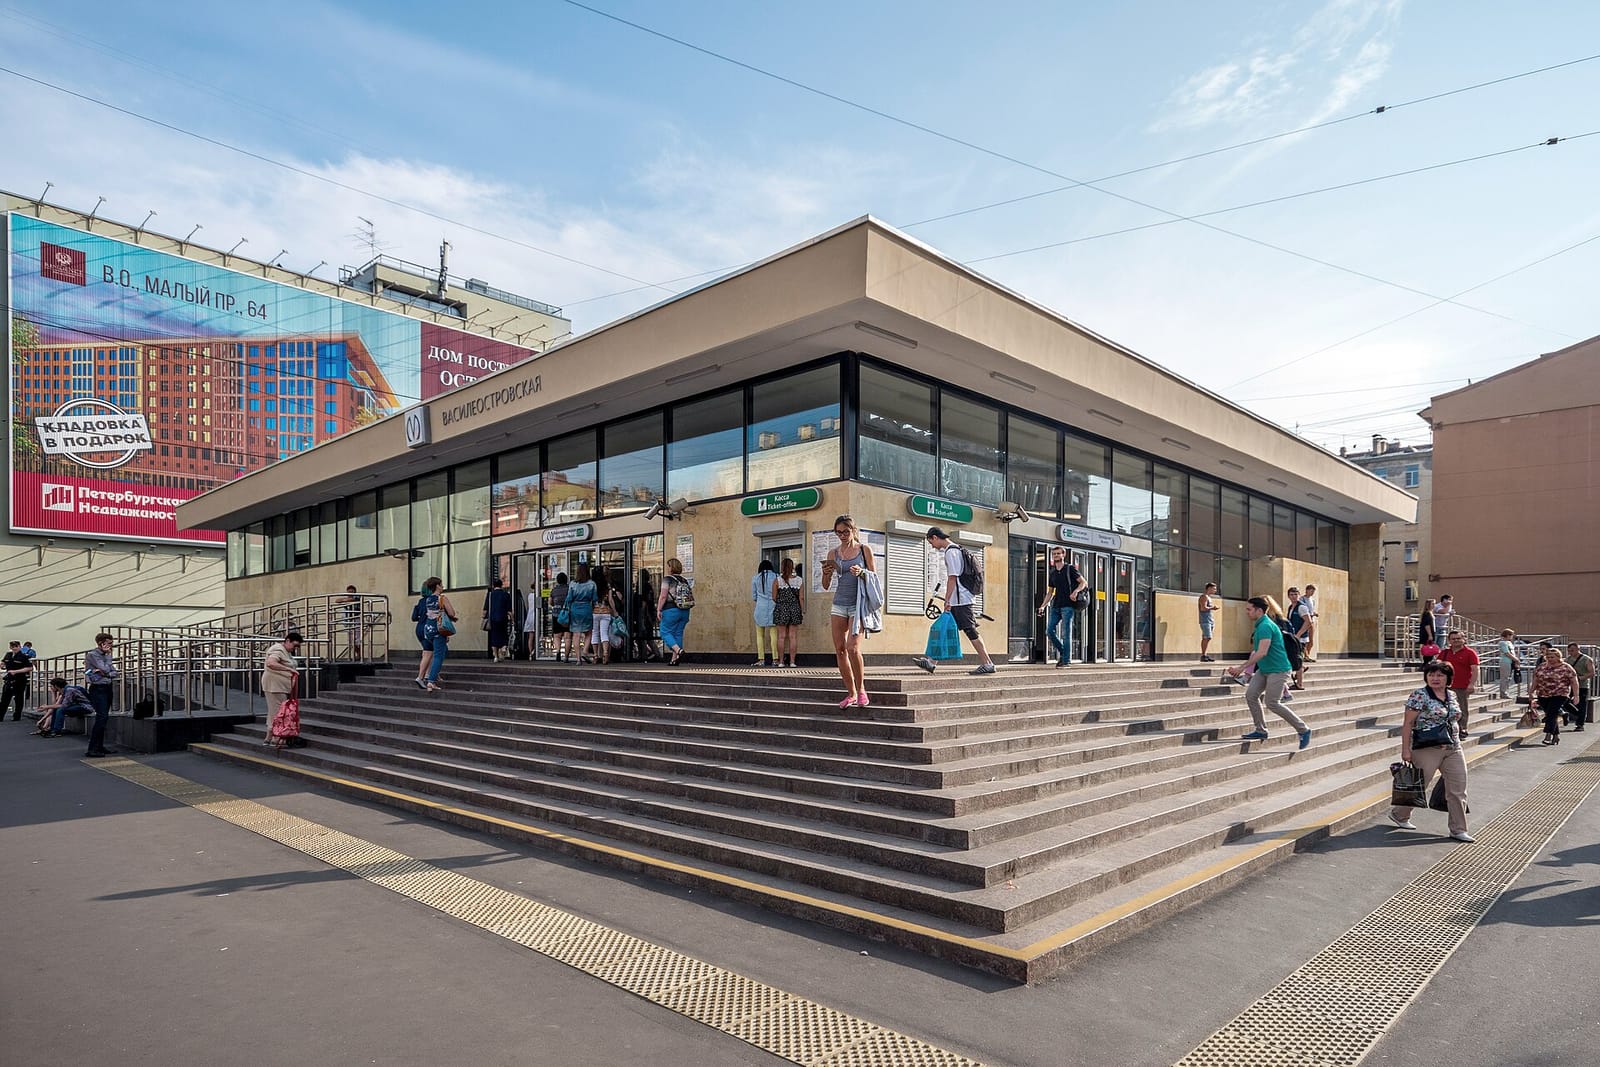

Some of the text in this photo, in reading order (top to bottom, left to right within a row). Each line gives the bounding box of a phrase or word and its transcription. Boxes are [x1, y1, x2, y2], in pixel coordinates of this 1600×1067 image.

[103, 264, 140, 291] В.О.,
[145, 274, 210, 307] МАЛЫЙ
[215, 292, 243, 316] ПР.,
[247, 301, 268, 320] 64
[427, 345, 512, 372] ДОМ ПОСТ
[442, 375, 542, 426] ВАСИЛЕОСТРОВСКАЯ
[42, 418, 142, 434] КЛАДОВКА
[45, 432, 148, 448] В ПОДАРОК
[767, 500, 798, 510] Ticket-office
[774, 494, 790, 502] Касса
